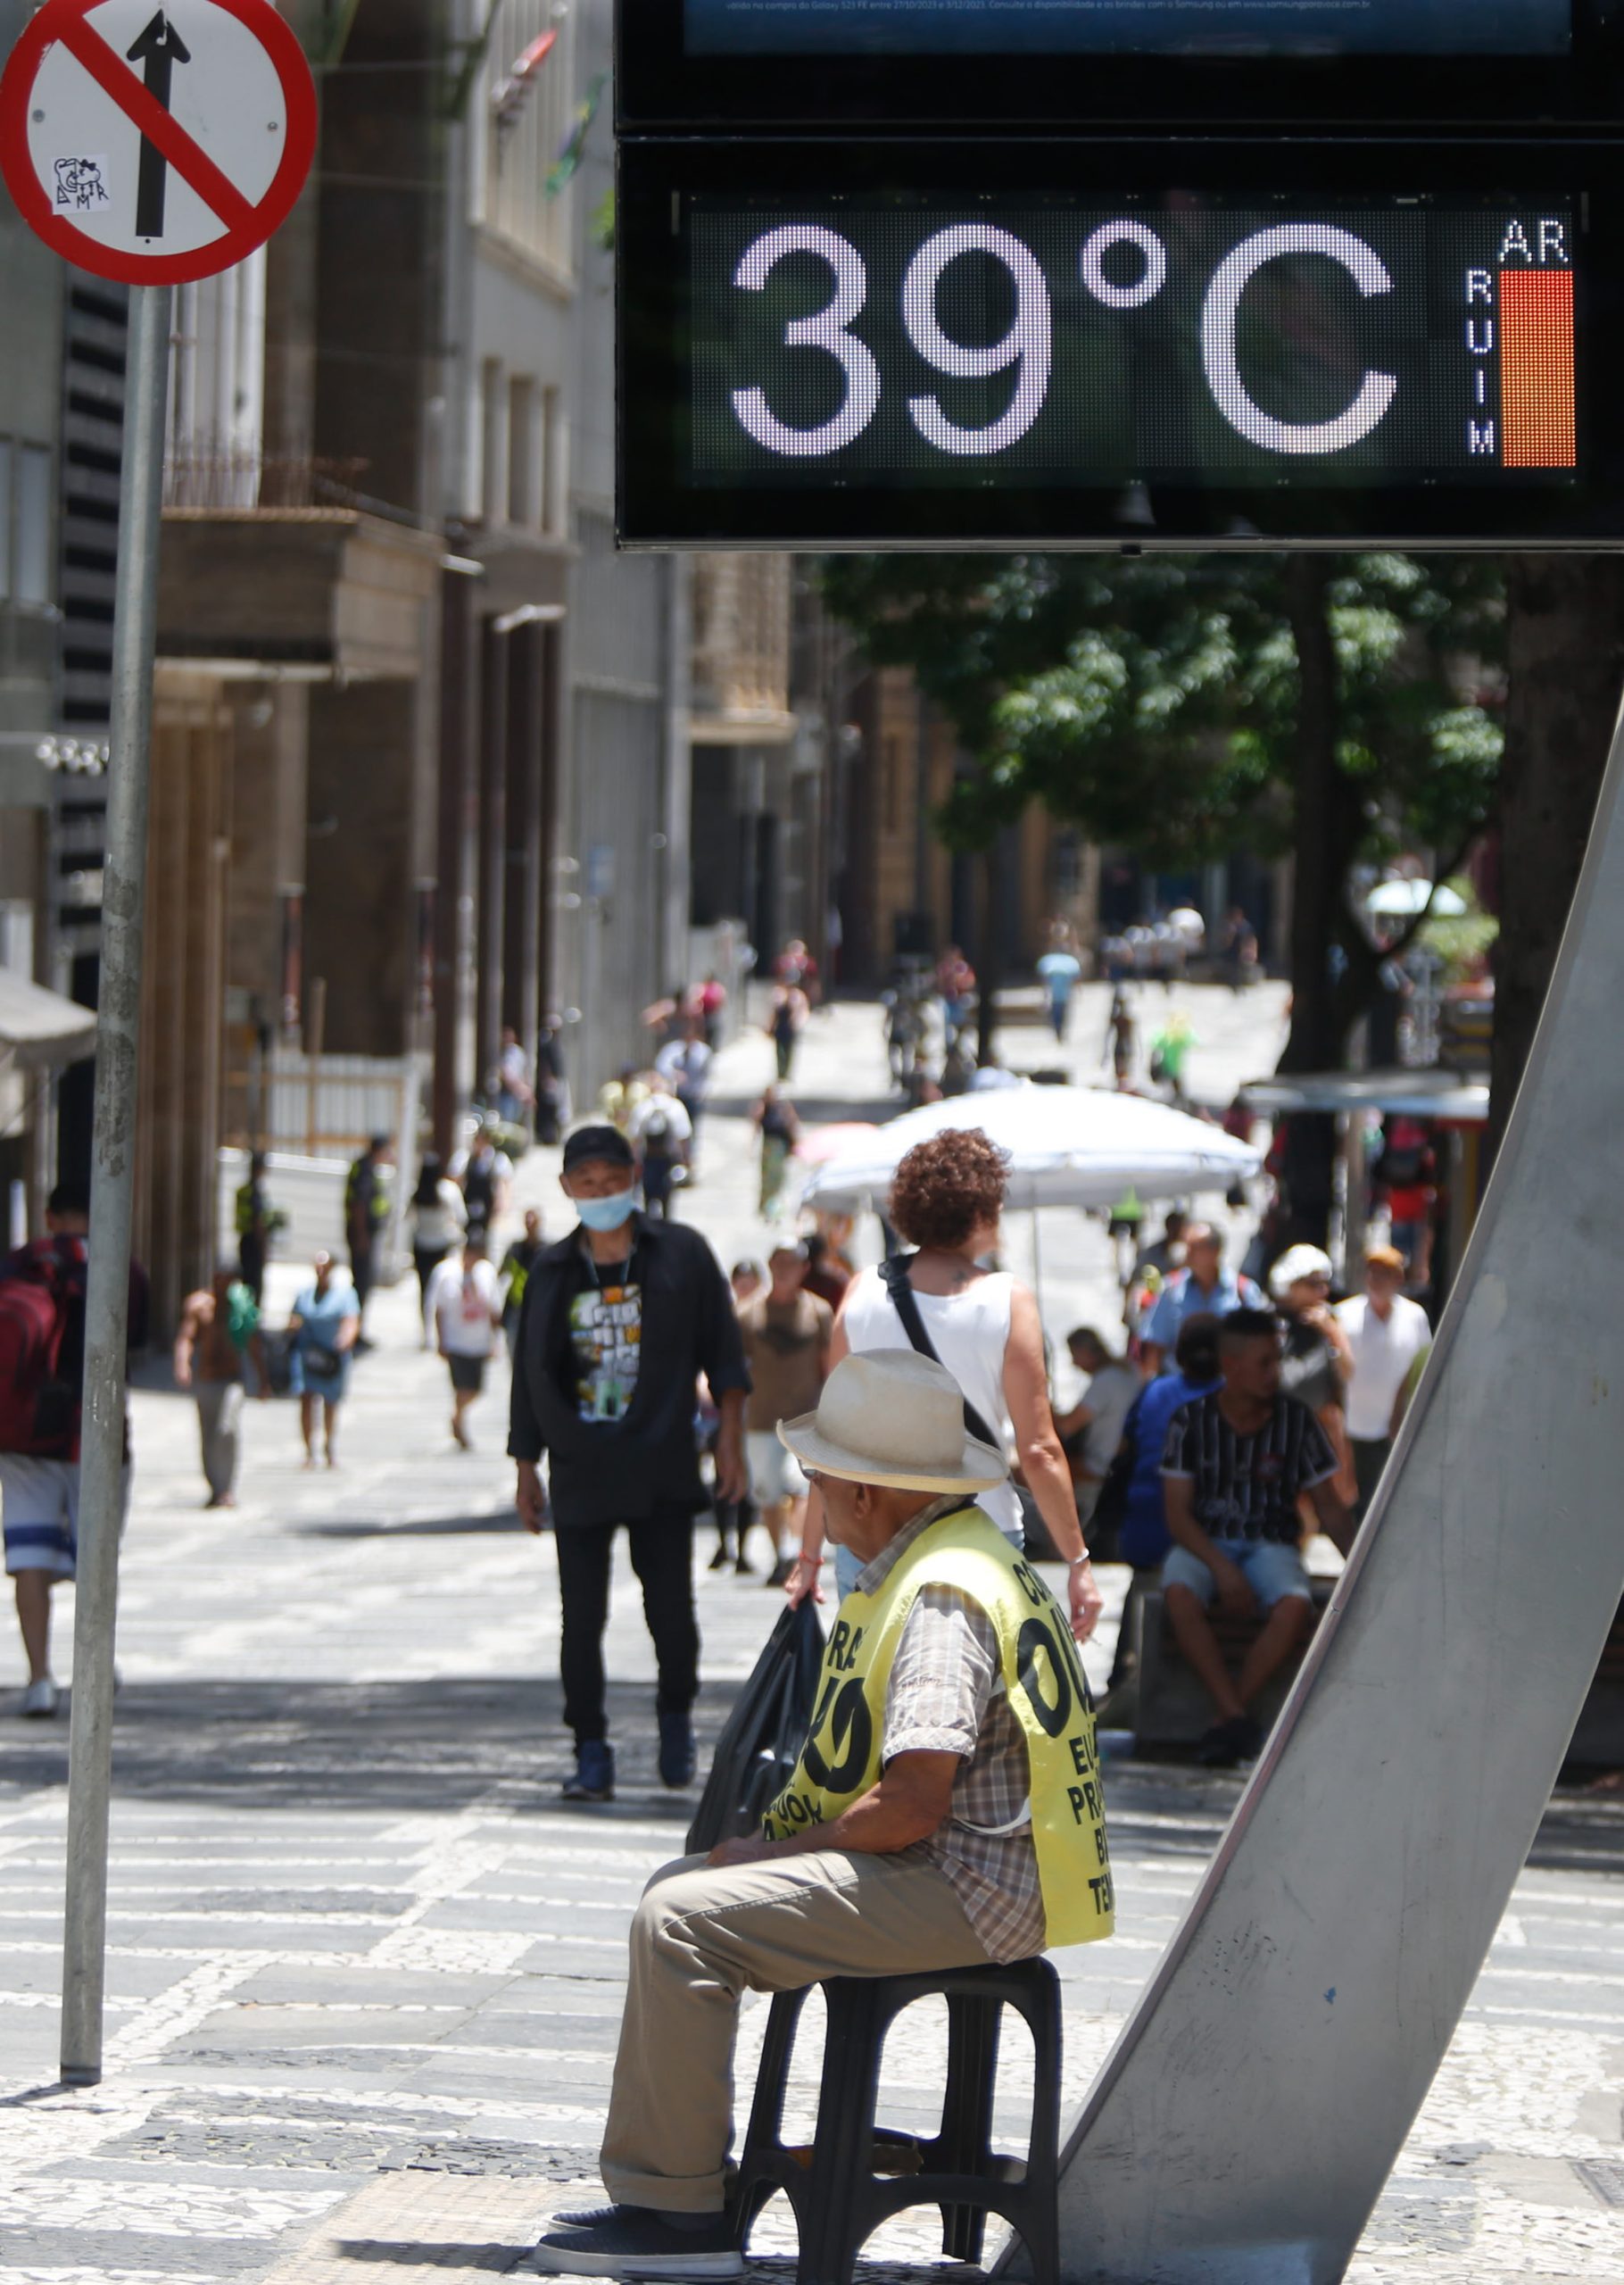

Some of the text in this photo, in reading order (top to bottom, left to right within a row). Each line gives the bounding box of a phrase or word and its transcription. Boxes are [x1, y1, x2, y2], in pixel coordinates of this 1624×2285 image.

[810, 1, 839, 12] Galaxy
[841, 1, 855, 10] S23
[858, 1, 866, 10] FE
[869, 2, 892, 10] entre
[989, 0, 1024, 9] Consulte
[1033, 0, 1095, 11] disponibilidade
[1115, 1, 1146, 9] brindes
[1175, 0, 1214, 11] Samsung
[1498, 218, 1570, 262] AR
[1465, 269, 1494, 454] RUIM
